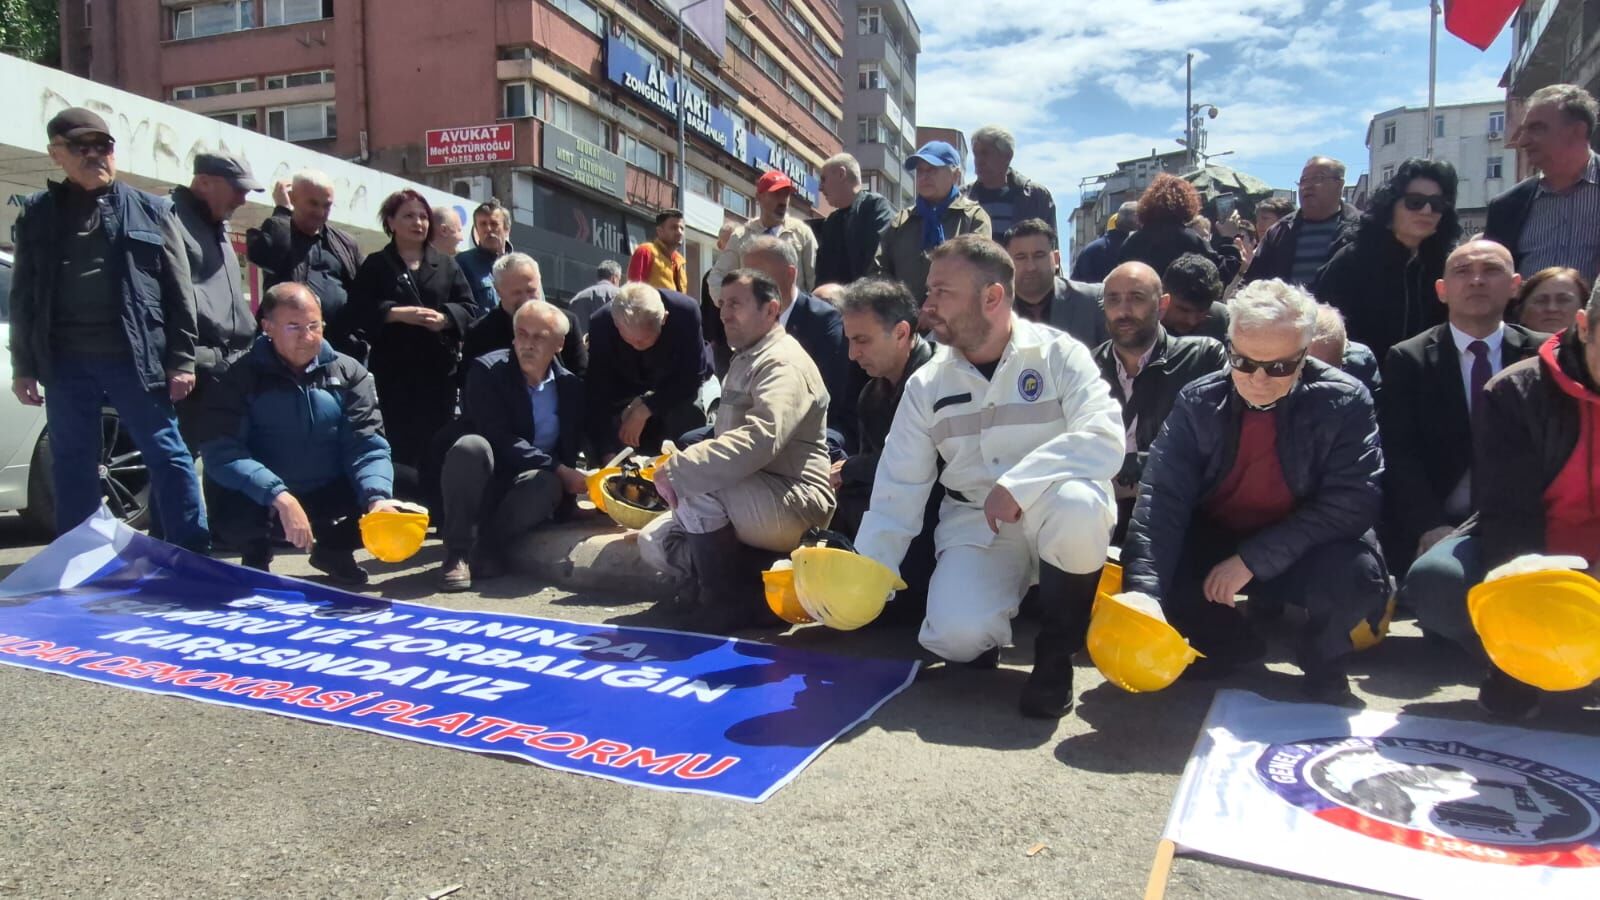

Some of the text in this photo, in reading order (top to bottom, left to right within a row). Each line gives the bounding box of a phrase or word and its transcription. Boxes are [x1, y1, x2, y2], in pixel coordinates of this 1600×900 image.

[625, 72, 678, 117] ZONGULDAK
[648, 64, 670, 97] AK
[430, 140, 511, 156] Mert ÖZTÜRKOĞLU
[440, 127, 499, 143] AVUKAT
[407, 612, 659, 662] YANINDA,
[96, 626, 531, 701] KARŞISINDAYIZ
[286, 626, 375, 645] VE
[352, 633, 737, 703] ZORBALIĞIN
[77, 655, 384, 712] DEMOKRASİ
[351, 698, 741, 780] PLATFORMU
[1268, 751, 1305, 784] GENEL
